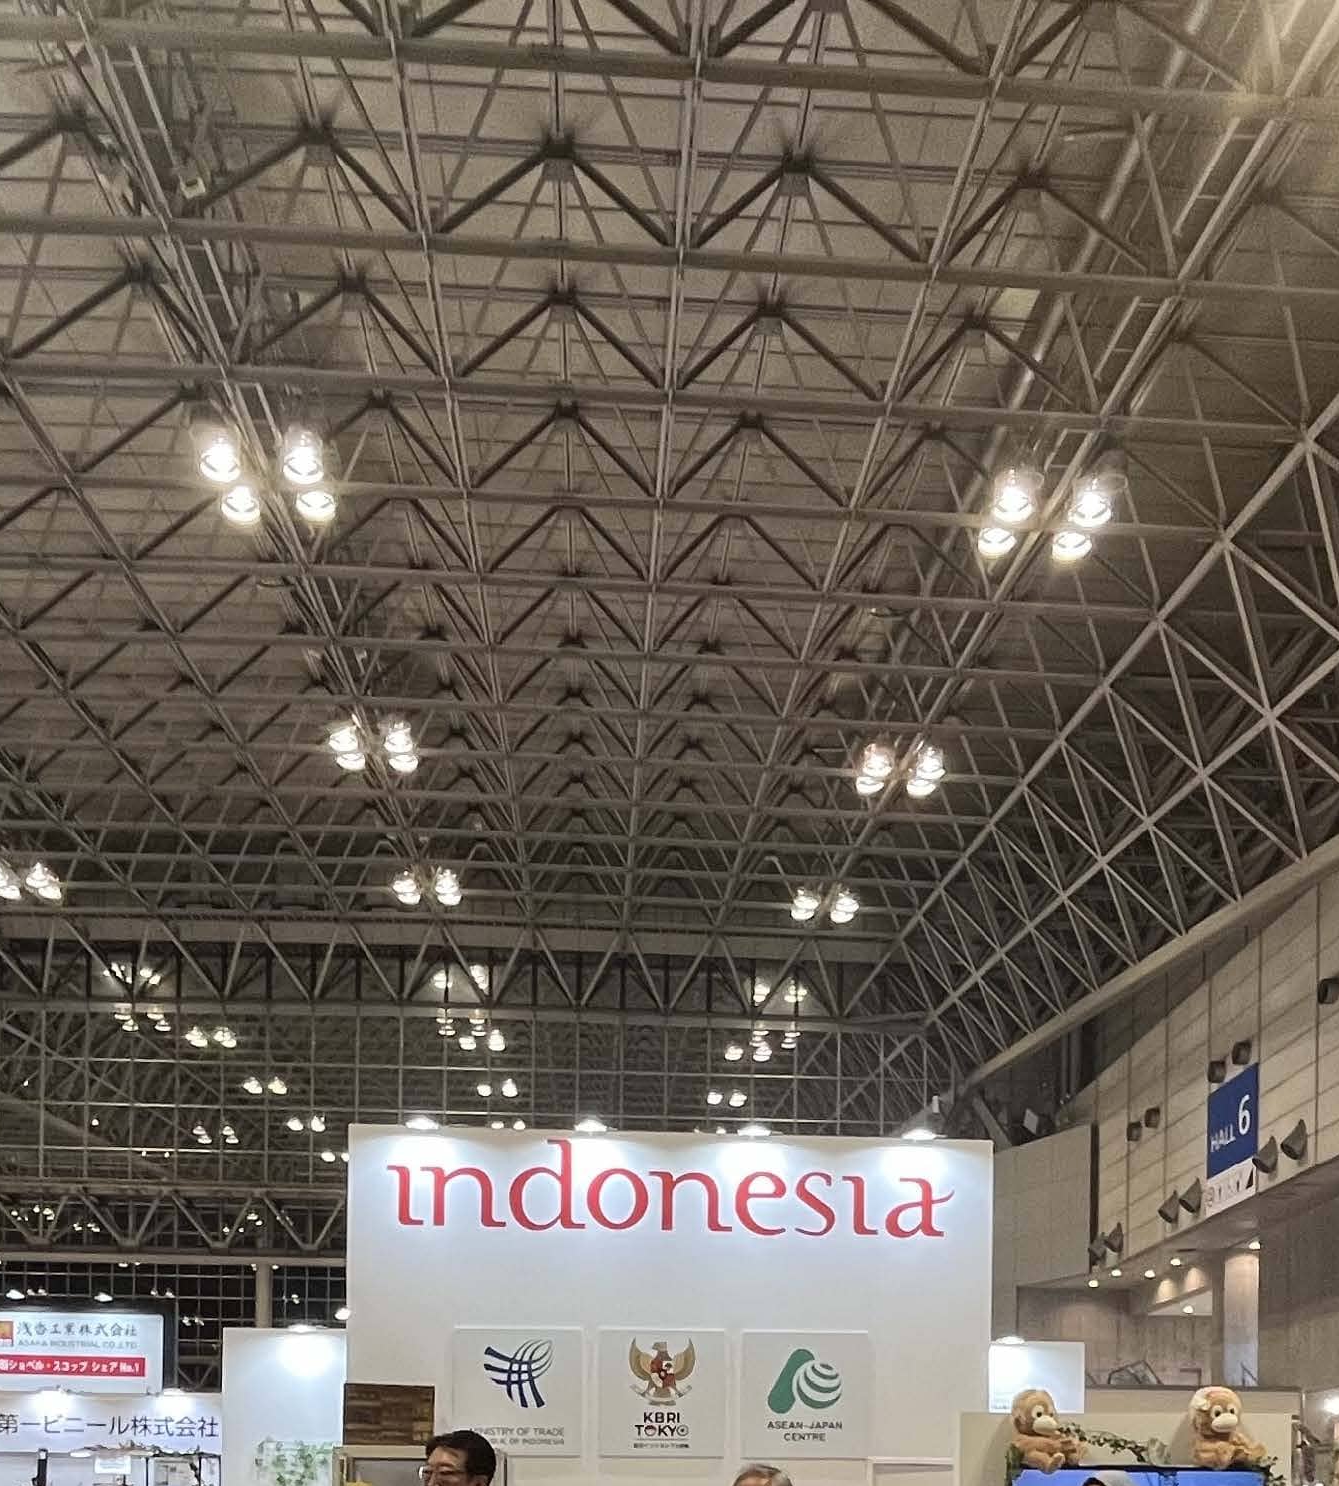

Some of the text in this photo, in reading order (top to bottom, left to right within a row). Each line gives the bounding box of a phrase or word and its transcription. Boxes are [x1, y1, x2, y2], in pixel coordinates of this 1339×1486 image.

[1210, 1093, 1251, 1152] HALL 6
[387, 1139, 955, 1238] indonesia
[643, 1412, 680, 1424] KBRI
[516, 1427, 530, 1436] OF
[634, 1425, 689, 1437] TOKYO
[767, 1421, 844, 1430] ASEAN-JAPAN
[783, 1433, 827, 1442] CENTRE
